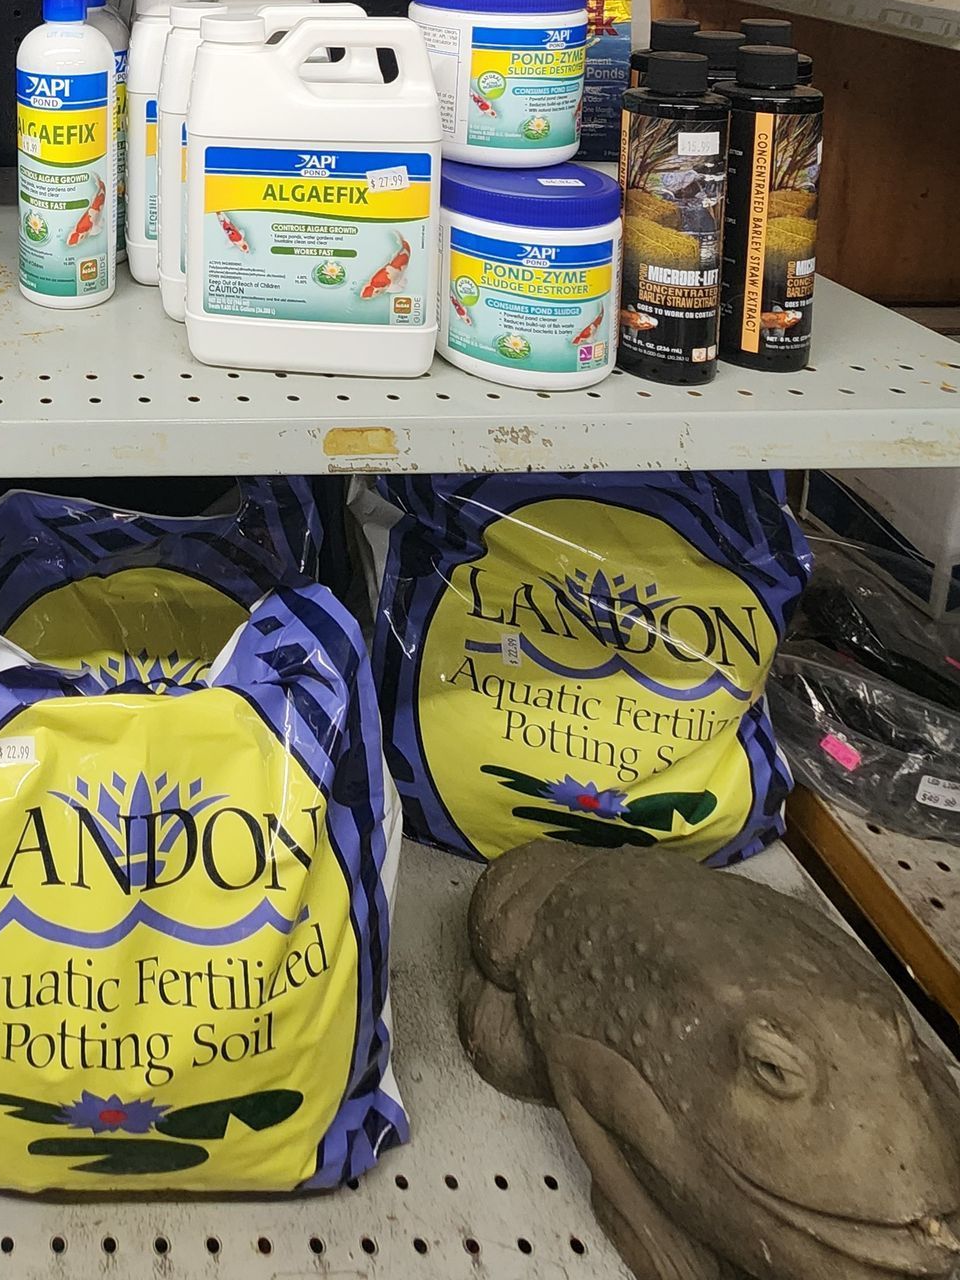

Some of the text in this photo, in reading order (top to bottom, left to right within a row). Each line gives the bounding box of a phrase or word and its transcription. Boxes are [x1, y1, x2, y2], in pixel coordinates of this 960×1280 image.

[511, 52, 584, 65] POND-ZYME
[587, 68, 625, 79] Ponds
[35, 78, 70, 97] API
[33, 98, 58, 106] POND
[307, 155, 336, 169] API
[379, 175, 403, 188] 27.99
[263, 184, 368, 204] ALGAEFIX
[272, 224, 357, 234] CONTROLS ALGAE GROWTH
[745, 132, 768, 333] CONCENTRATED BARLEY STRAW EXTRACT
[294, 248, 317, 256] WORKS
[528, 247, 556, 259] API
[484, 262, 587, 283] POND-ZYME
[648, 266, 719, 286] MICROBE-LIFT
[209, 286, 245, 294] CAUTION
[481, 276, 589, 295] SLUDGE DESTROYER
[639, 282, 718, 297] CONCENTRATED
[487, 300, 529, 313] CONSUMES
[531, 307, 552, 315] POND
[466, 565, 763, 667] LANDON
[446, 655, 741, 744] Aquatic Fertiliz
[7, 743, 30, 759] 22.99
[502, 709, 641, 783] Potting
[134, 923, 331, 1011] Fertilized
[0, 1012, 276, 1088] Potting Soil
